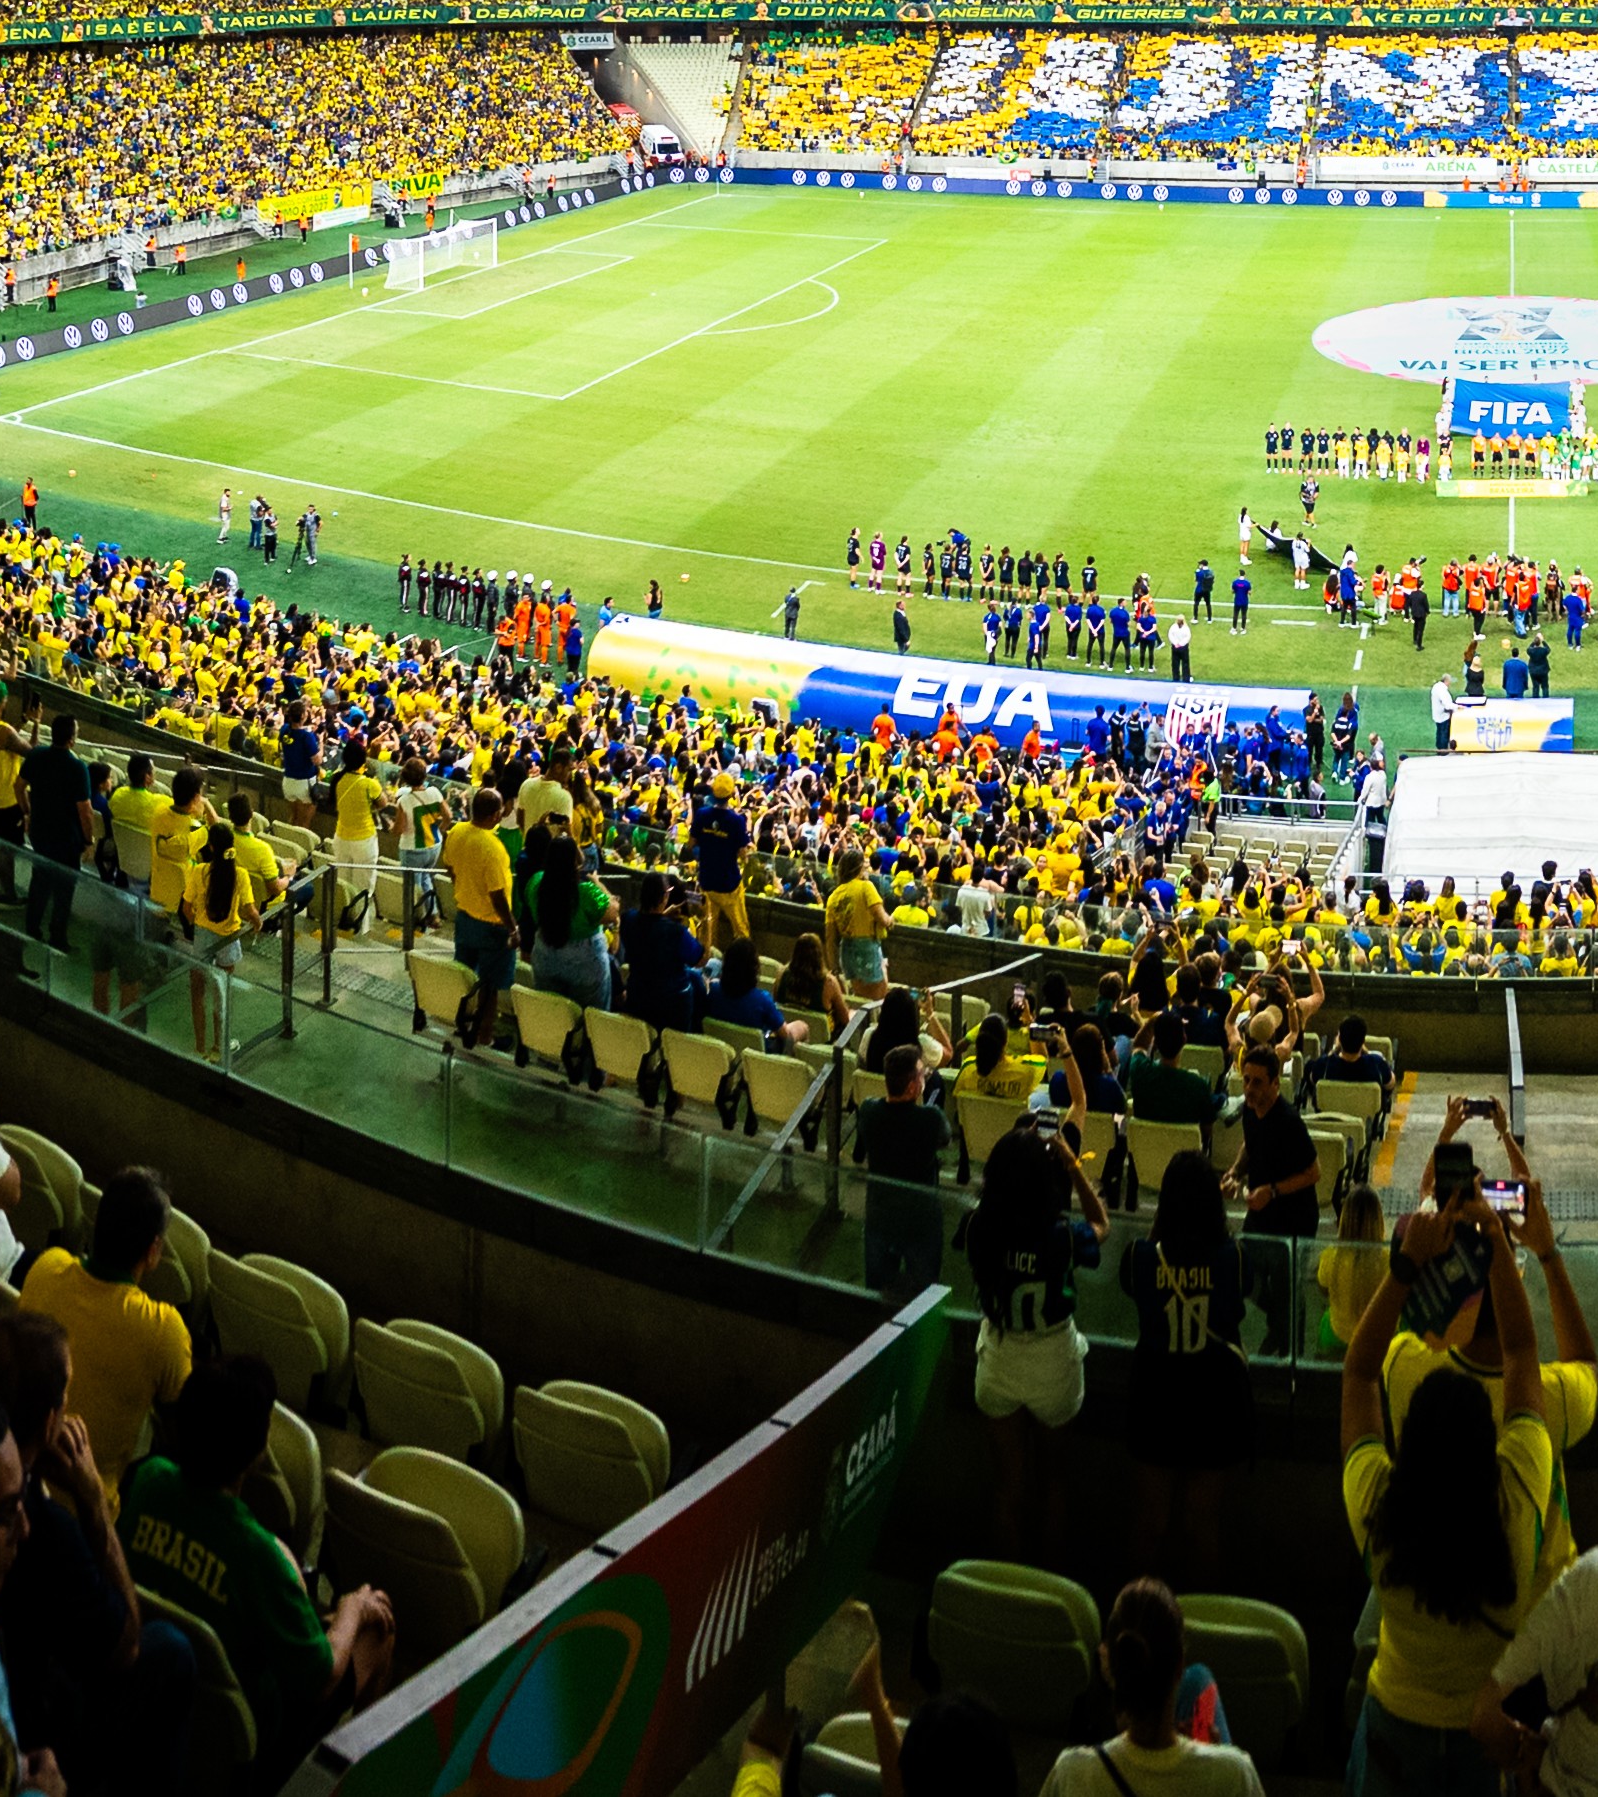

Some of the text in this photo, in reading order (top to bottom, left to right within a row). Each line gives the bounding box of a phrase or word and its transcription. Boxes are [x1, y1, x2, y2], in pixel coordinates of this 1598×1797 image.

[351, 9, 437, 22] LAUREN
[476, 7, 585, 20] D.SAMPAIO
[625, 5, 737, 19] RAFAELLE
[776, 6, 886, 19] DUDINHA
[938, 6, 1036, 20] ANGELINA
[1076, 7, 1186, 20] GUTIERRES
[1239, 8, 1335, 22] MARTA
[1375, 10, 1485, 23] KEROLIN
[218, 13, 316, 28] TARCIANE
[86, 20, 186, 36] ISABELA
[578, 34, 609, 44] CEARÁ
[1399, 360, 1448, 371] VAI
[1459, 359, 1519, 371] SER
[1469, 400, 1553, 425] FIFA
[892, 669, 1055, 733] EUA
[1174, 696, 1223, 714] USA
[1156, 1265, 1215, 1291] BRASIL
[1163, 1293, 1211, 1355] 10
[845, 1389, 899, 1488] CEARÁ
[131, 1513, 228, 1606] BRASIL
